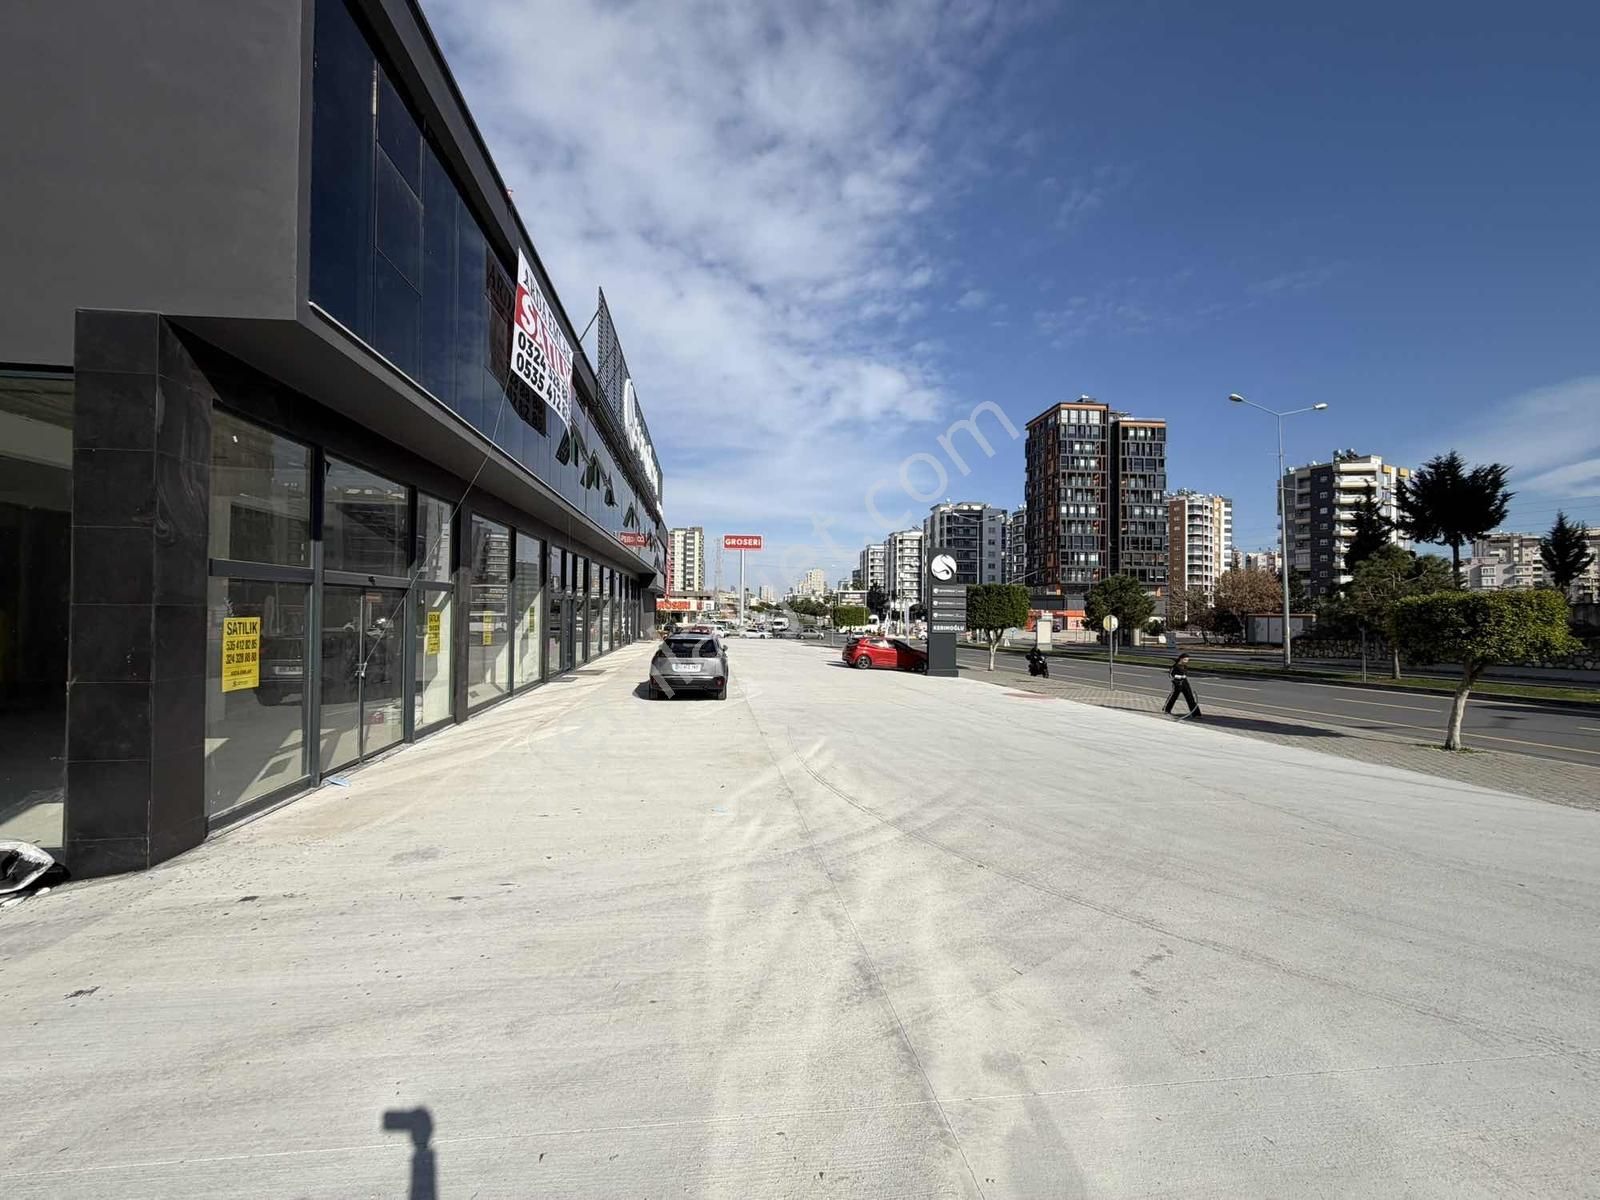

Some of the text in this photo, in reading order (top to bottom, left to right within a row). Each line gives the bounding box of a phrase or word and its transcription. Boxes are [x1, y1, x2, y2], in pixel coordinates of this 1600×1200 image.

[516, 352, 545, 392] 0535
[518, 331, 546, 373] 0324
[227, 621, 258, 636] SATILIK
